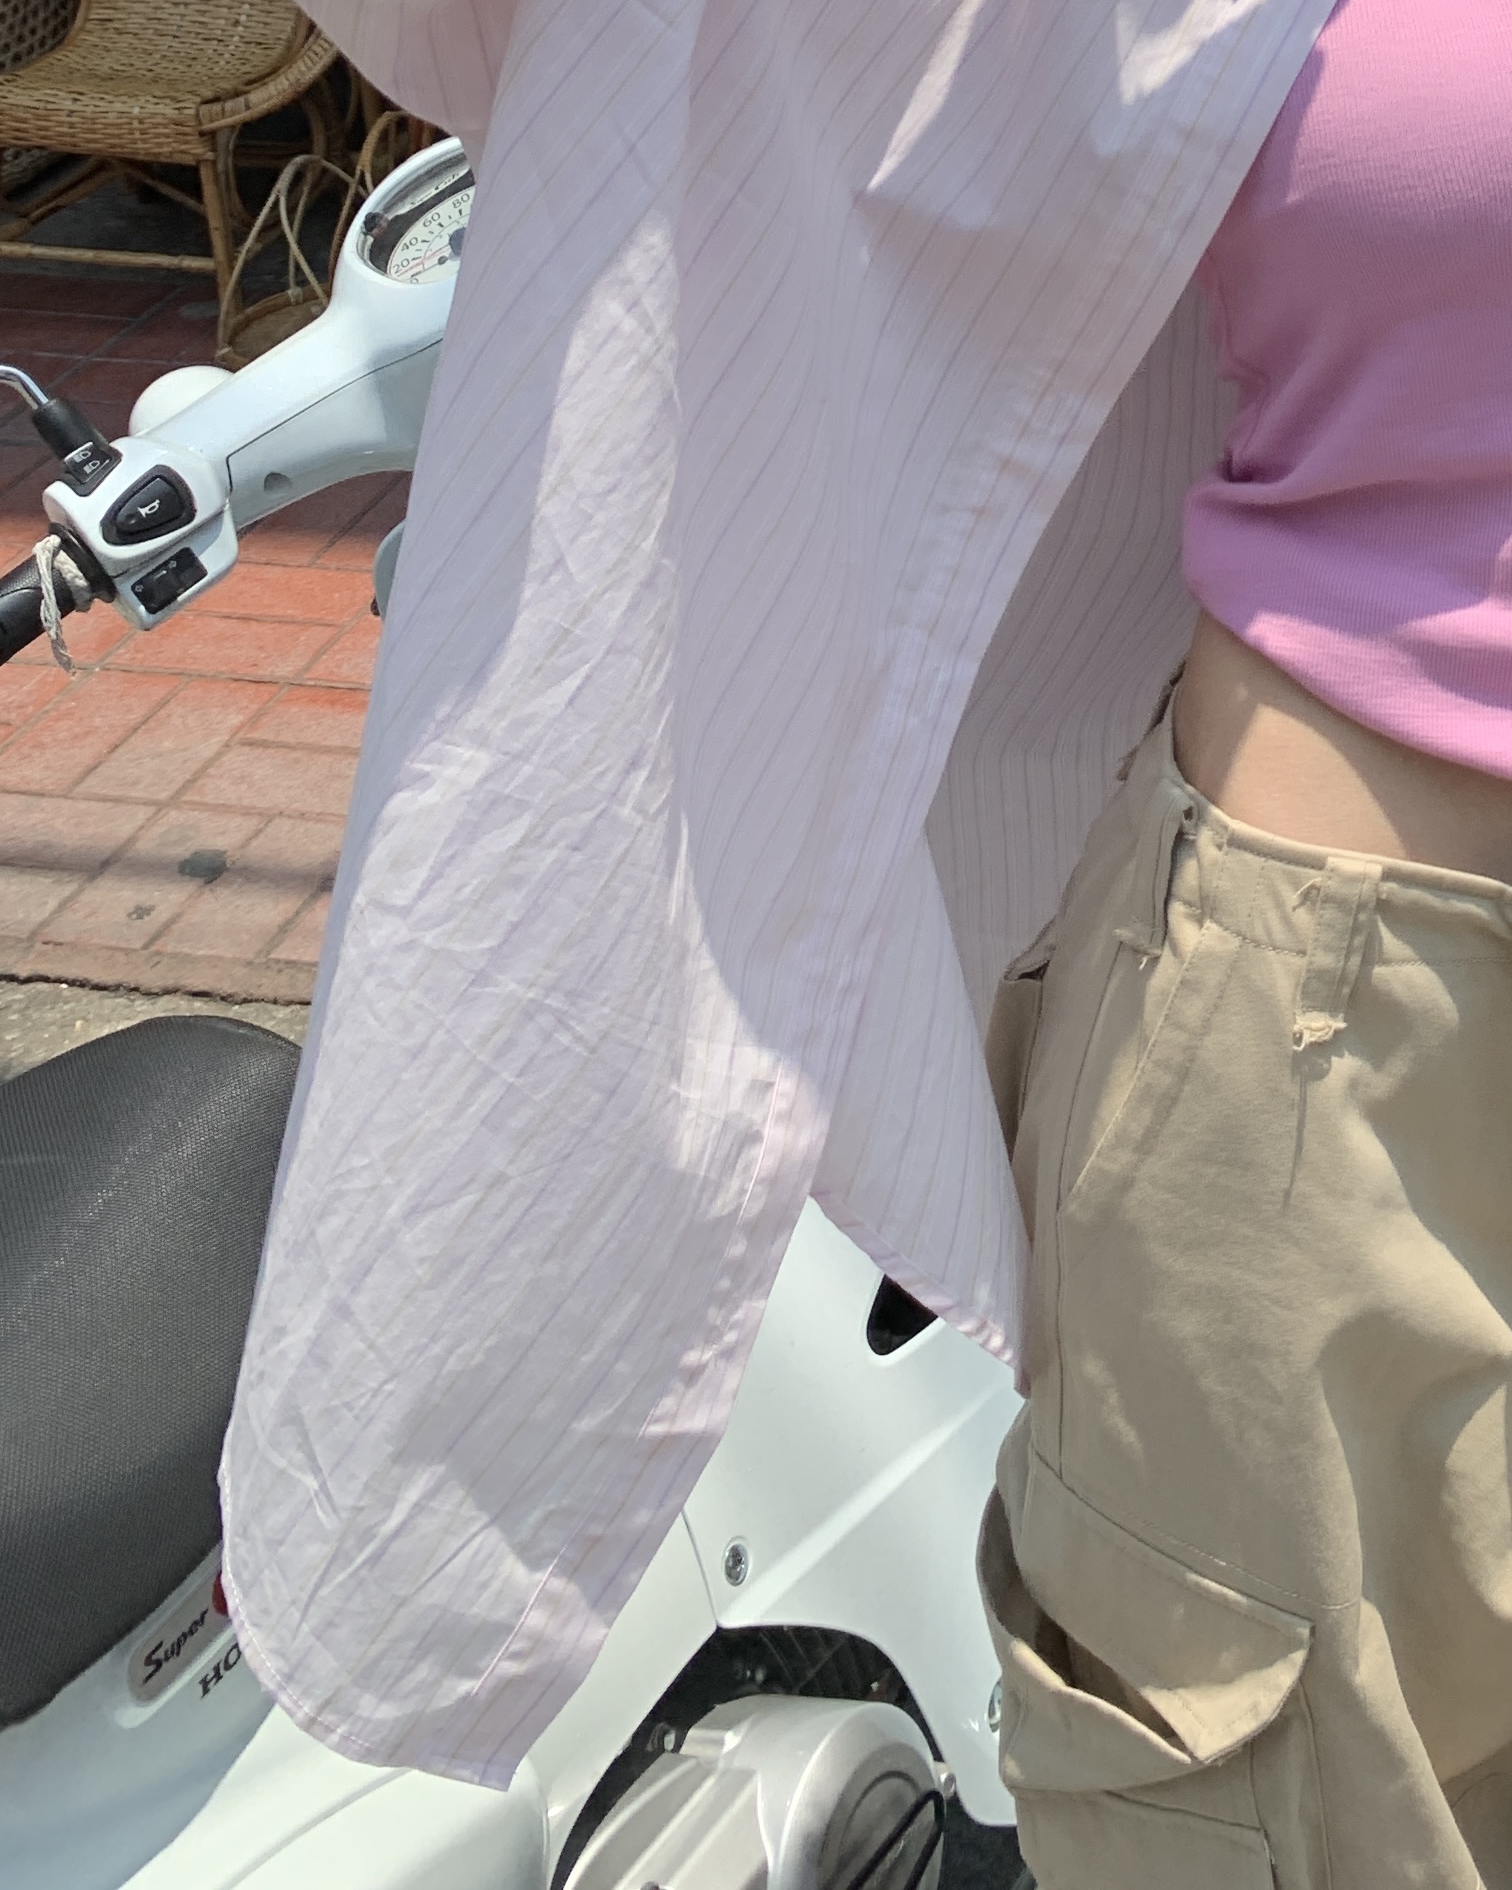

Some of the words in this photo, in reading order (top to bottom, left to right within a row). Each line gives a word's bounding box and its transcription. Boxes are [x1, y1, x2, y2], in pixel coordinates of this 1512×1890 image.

[452, 192, 471, 209] 80
[422, 211, 441, 228] 60
[400, 236, 419, 252] 40
[392, 258, 410, 274] 20
[143, 1608, 209, 1685] Super
